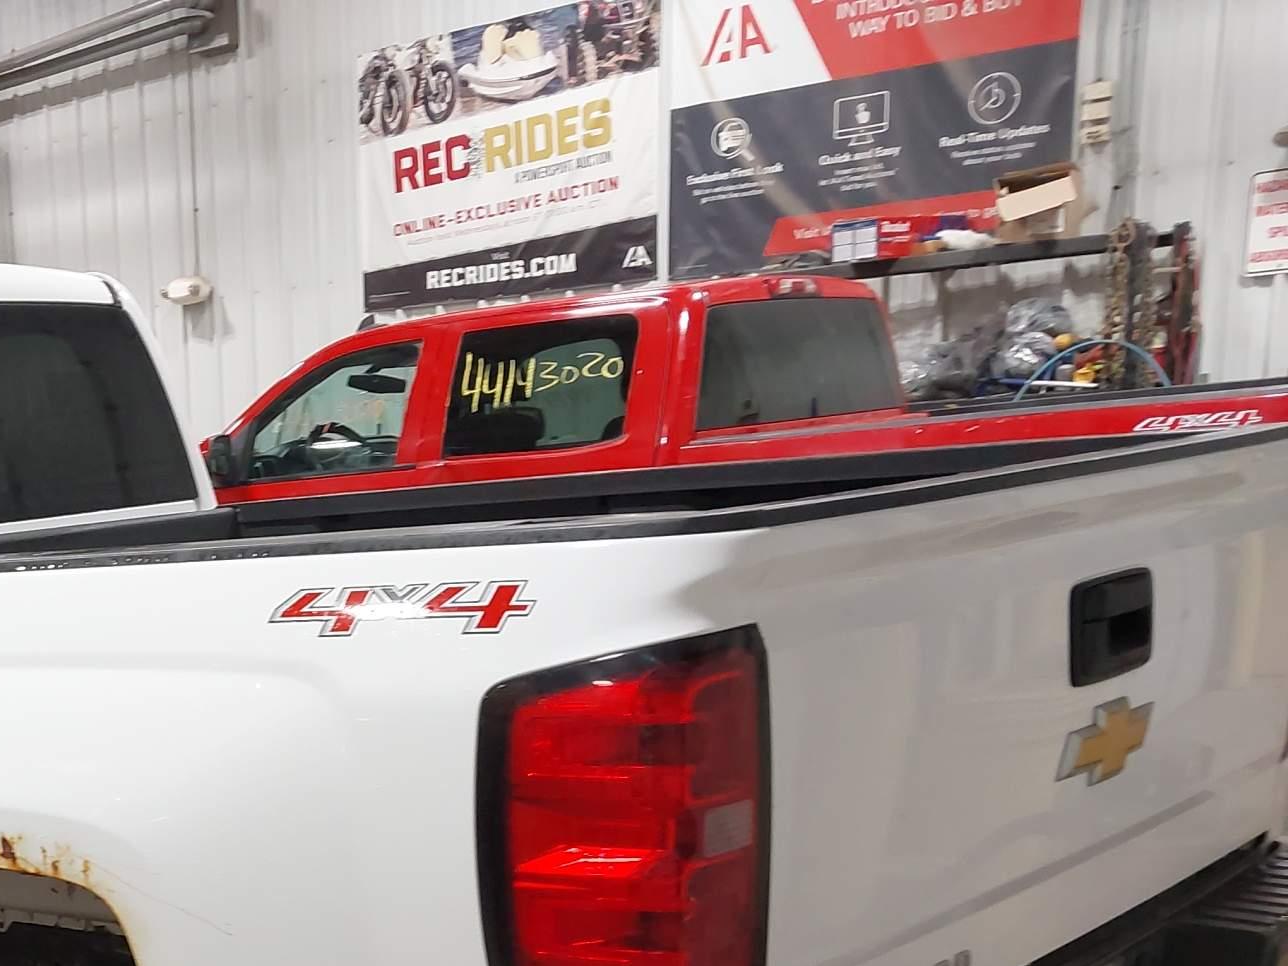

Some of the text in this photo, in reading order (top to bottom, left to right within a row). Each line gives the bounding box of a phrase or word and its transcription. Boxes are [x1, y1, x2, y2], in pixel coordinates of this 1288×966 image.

[848, 15, 890, 38] WAY
[893, 9, 919, 29] TO
[924, 2, 958, 23] BID
[393, 134, 472, 193] REC
[483, 98, 613, 173] RIDES
[393, 193, 541, 237] ONLINE-EXCLUSIVE
[546, 176, 620, 204] AUCTION
[425, 253, 578, 290] RECRIDES.COM
[462, 351, 625, 413] 44143020
